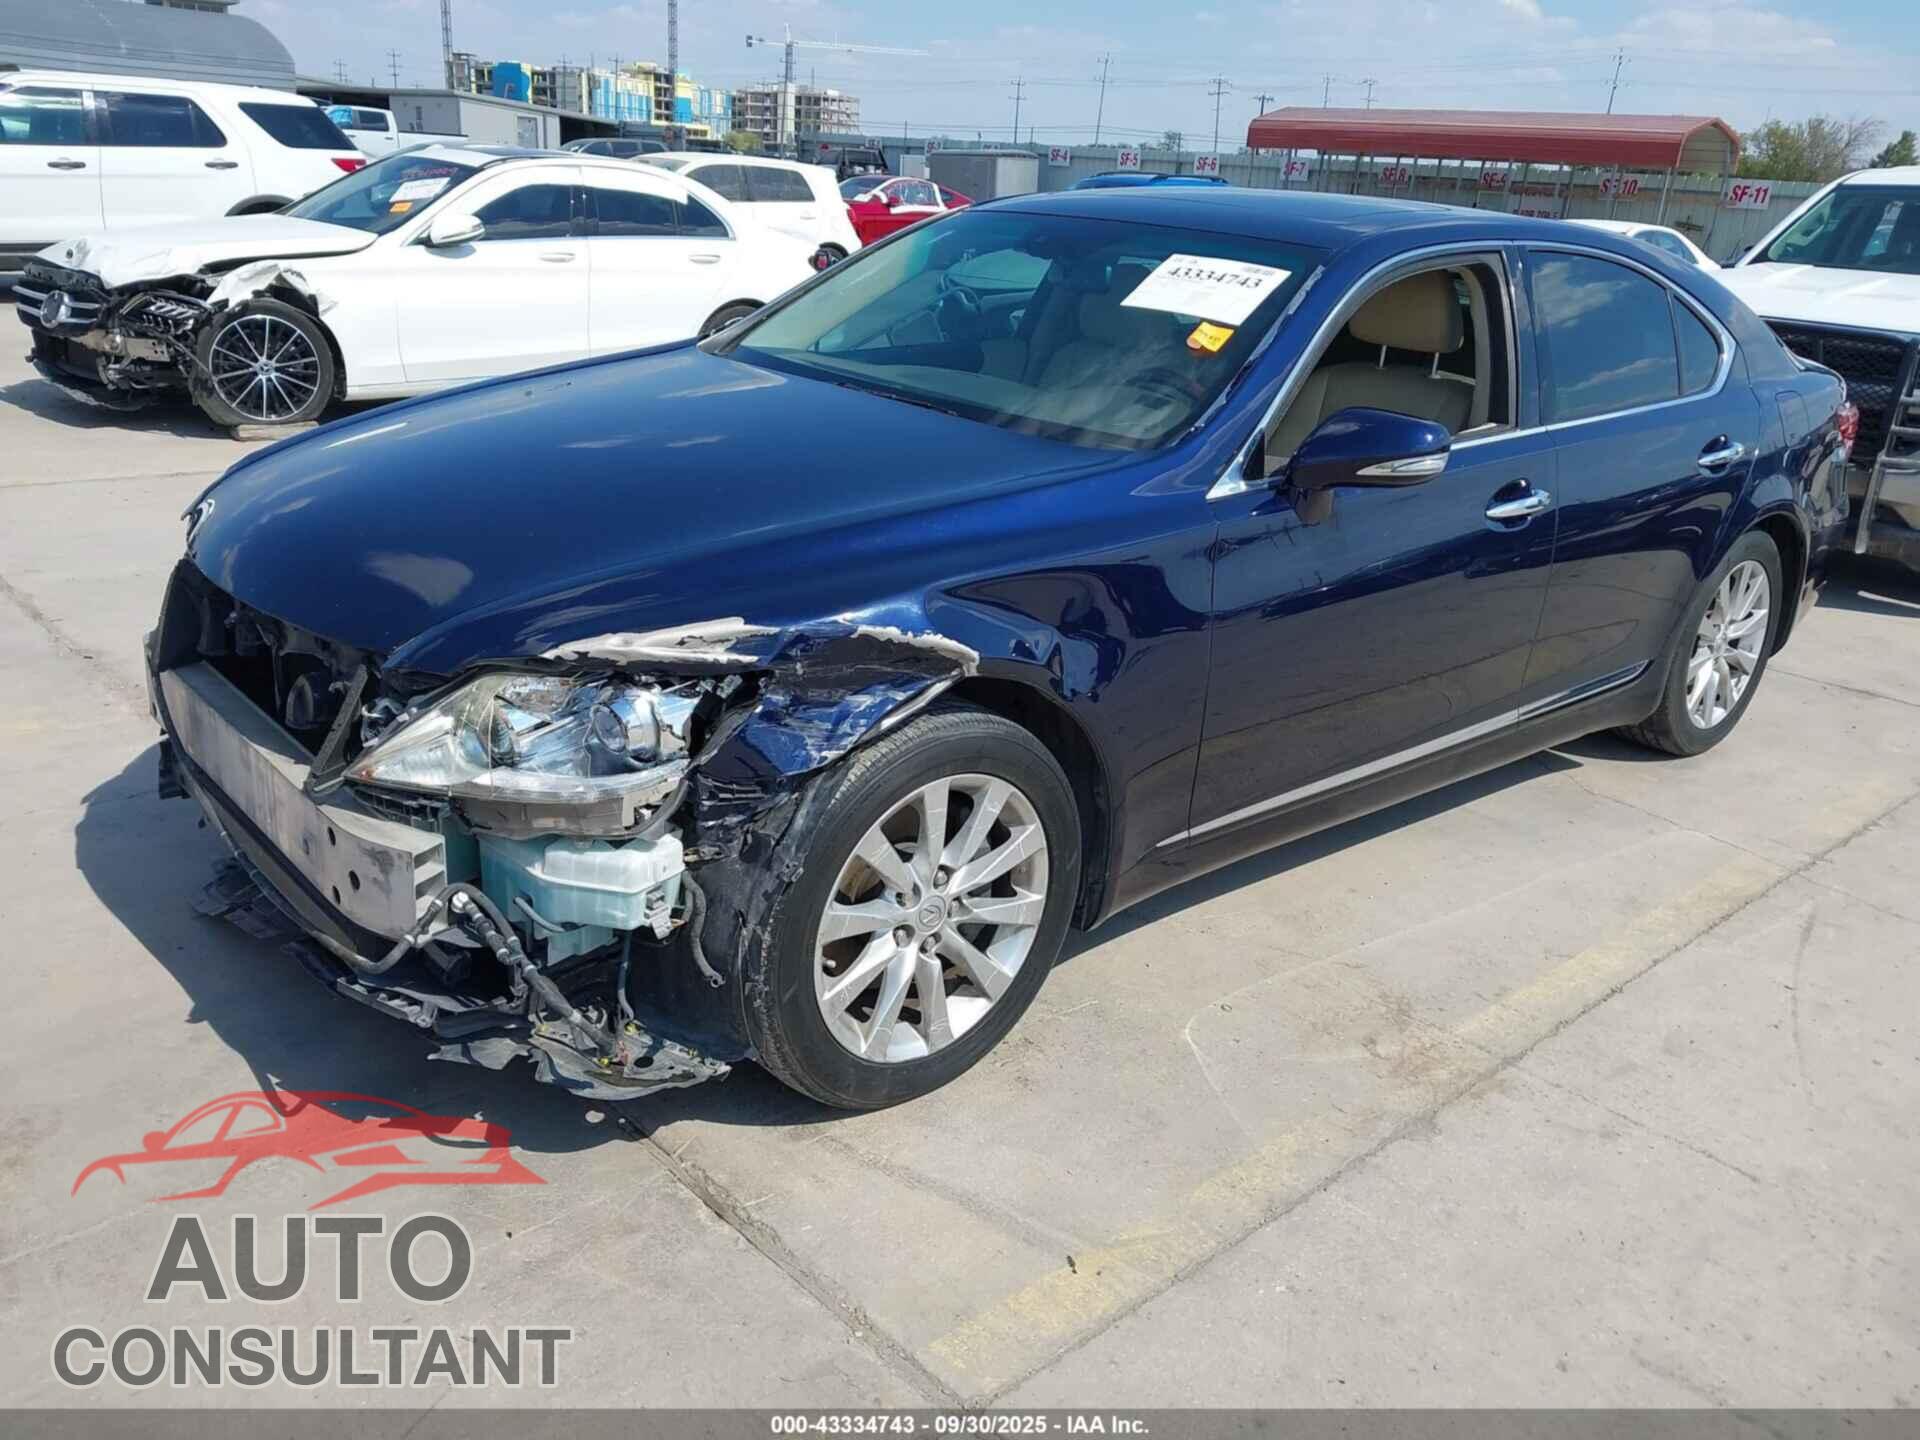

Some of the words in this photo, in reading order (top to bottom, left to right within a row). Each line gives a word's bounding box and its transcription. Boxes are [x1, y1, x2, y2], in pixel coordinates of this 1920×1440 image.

[1119, 152, 1139, 167] SF-5
[1195, 156, 1218, 172] SF-6
[1729, 184, 1770, 204] SF-11
[1168, 266, 1263, 289] 43334743
